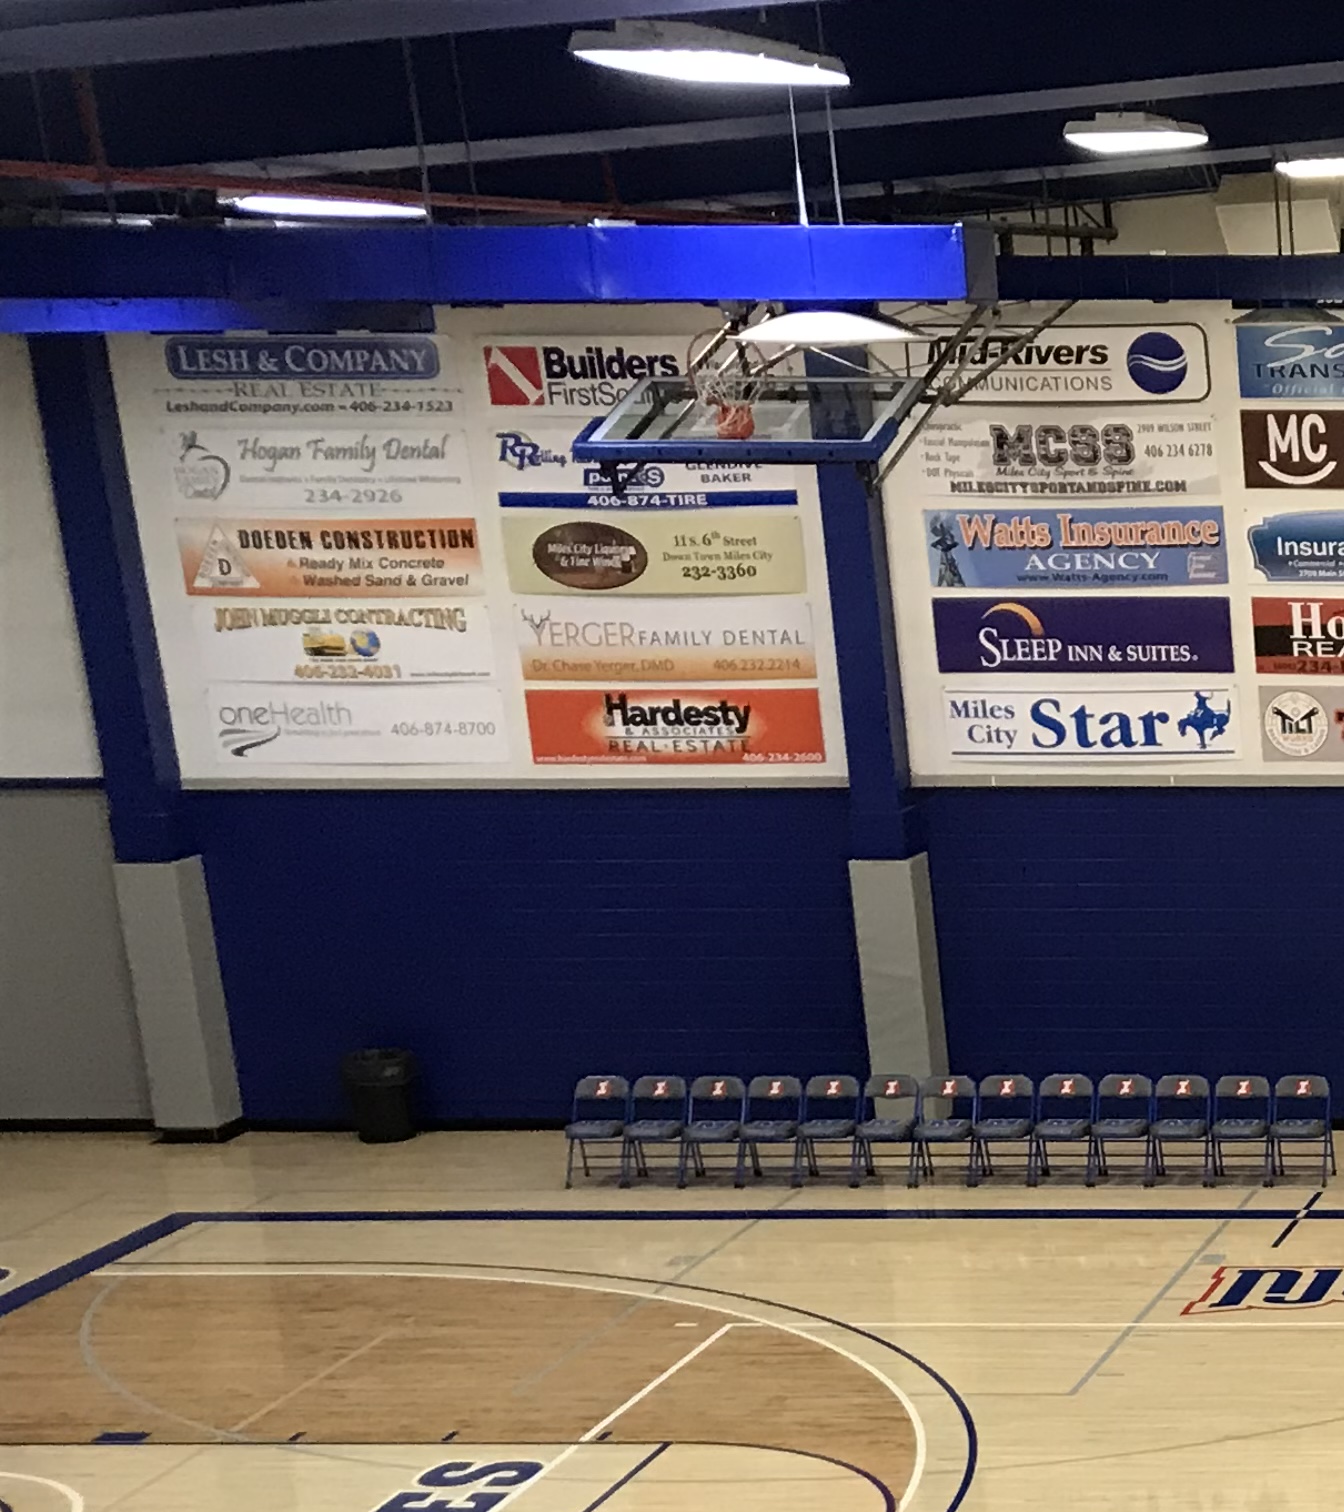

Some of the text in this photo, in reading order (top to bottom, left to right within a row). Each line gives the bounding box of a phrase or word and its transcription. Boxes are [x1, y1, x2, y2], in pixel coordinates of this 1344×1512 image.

[178, 345, 427, 373] LESH COMPANY
[544, 347, 679, 378] Builders
[233, 382, 382, 398] REAL ESTATE
[990, 424, 1135, 466] MCSS
[1267, 414, 1328, 462] MC
[237, 433, 449, 472] Hogan Family Dental
[701, 473, 752, 483] BAKER
[587, 494, 708, 506] 406-874-TIRE
[320, 528, 474, 549] CONSTRUCTION
[723, 536, 757, 546] Street
[957, 513, 1220, 548] Watts Insurance
[299, 557, 444, 571] Ready Mix Concrete
[682, 565, 756, 580] 232-3360
[1024, 553, 1160, 571] AGENCY
[303, 575, 469, 587] Washed Sand Gravel
[639, 629, 805, 646] FAMILY DENTAL
[978, 627, 1102, 667] SLEEP INN
[605, 693, 750, 733] Hardesty
[950, 701, 1015, 719] Miles
[1030, 698, 1169, 748] Star
[967, 726, 1017, 748] City
